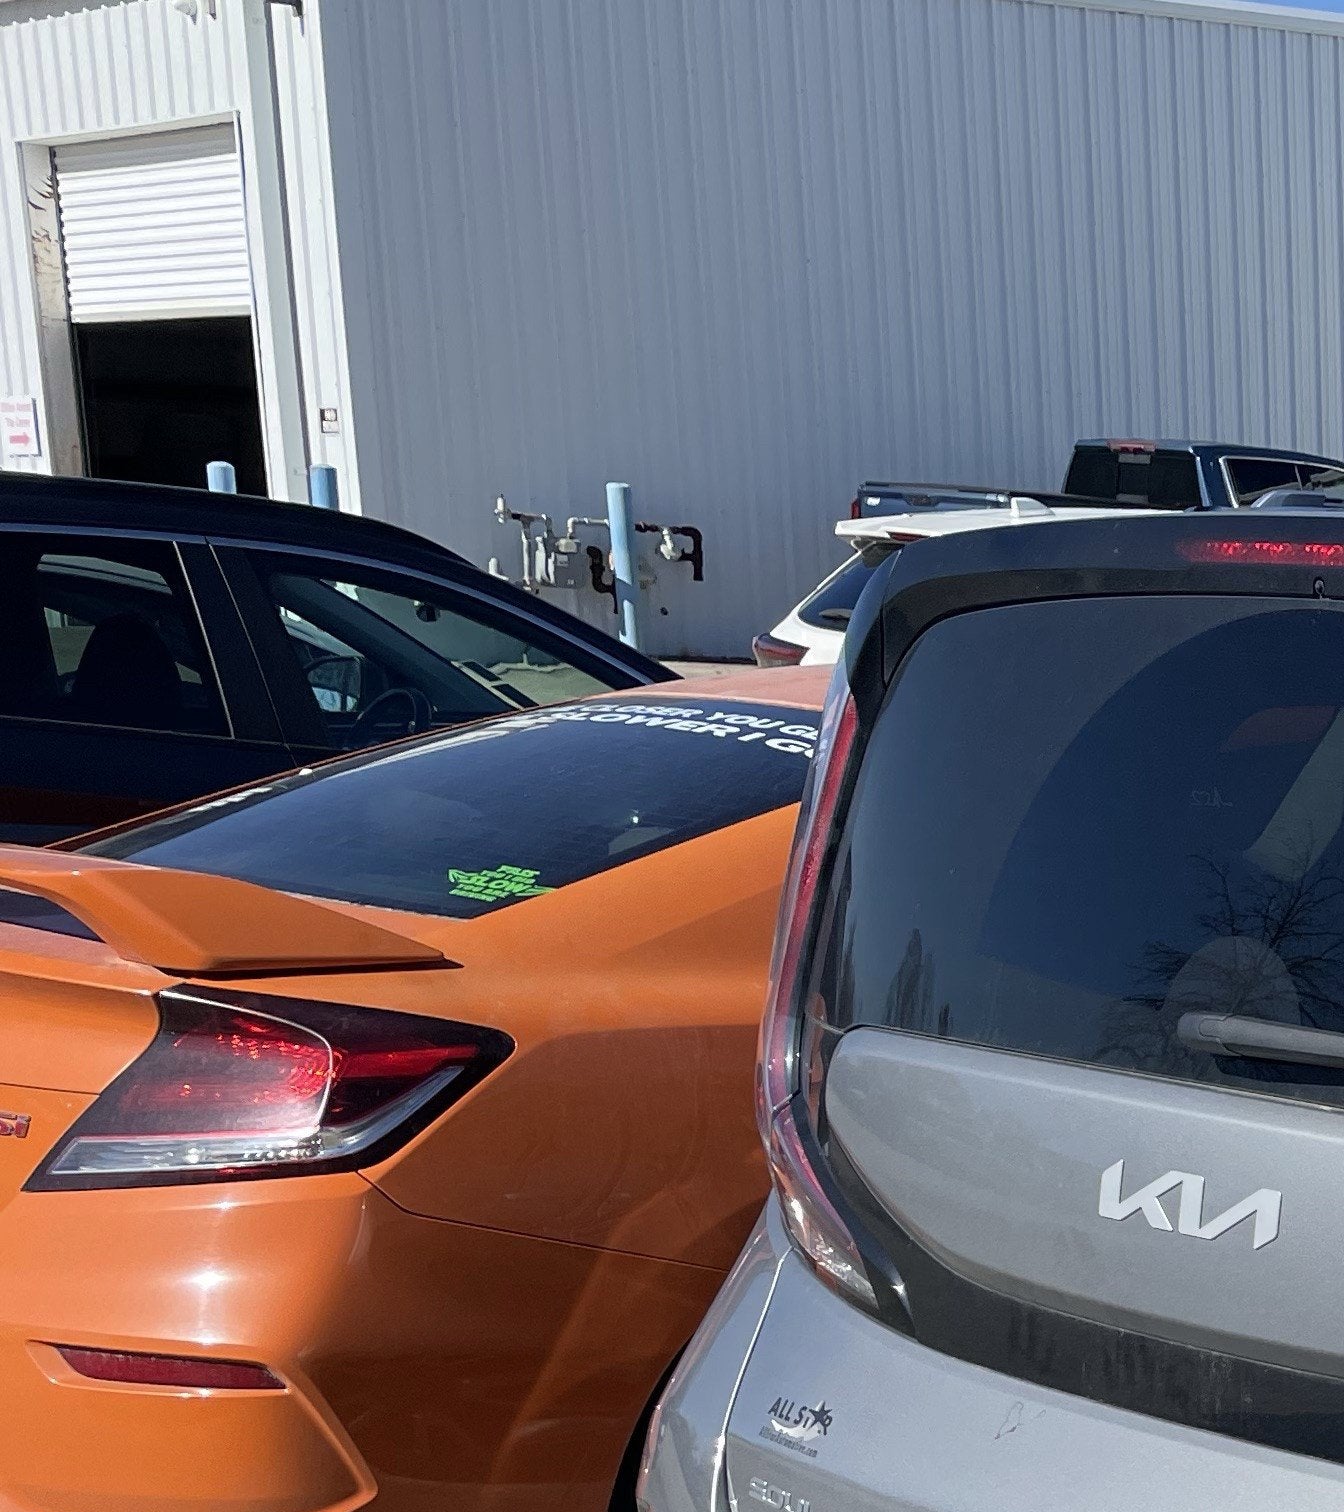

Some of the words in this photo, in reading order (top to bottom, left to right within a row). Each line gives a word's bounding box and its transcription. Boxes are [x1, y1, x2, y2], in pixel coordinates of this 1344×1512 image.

[705, 712, 785, 729] YOU
[1099, 1159, 1282, 1251] KIA
[767, 1396, 795, 1422] ALL
